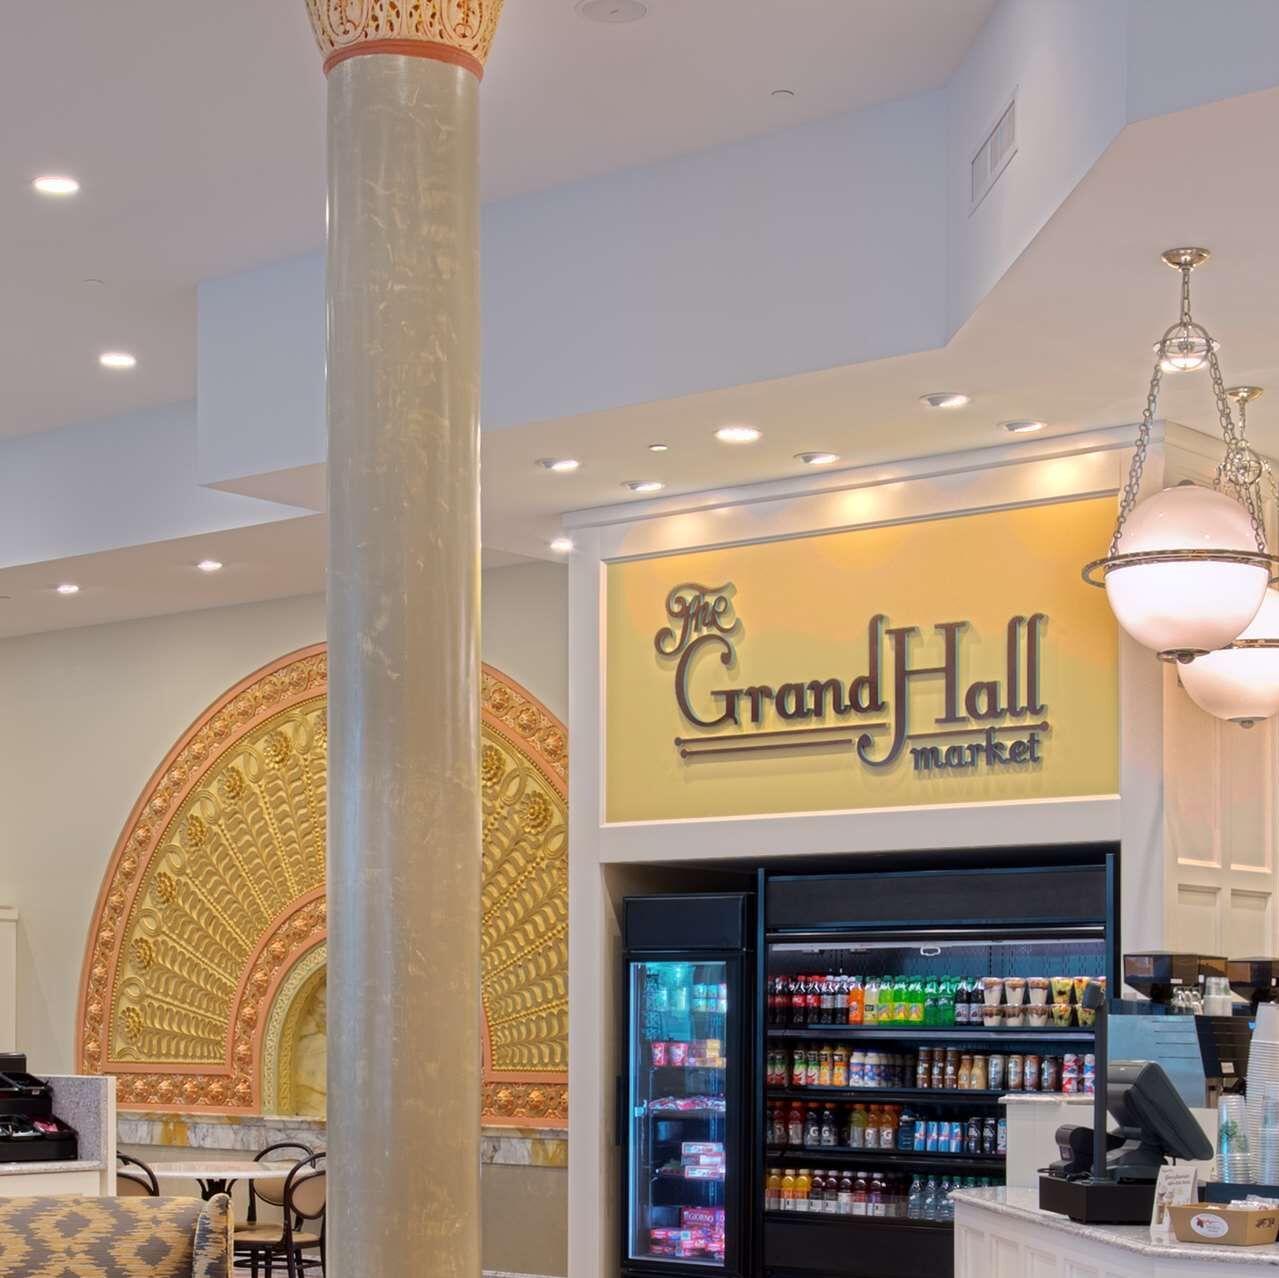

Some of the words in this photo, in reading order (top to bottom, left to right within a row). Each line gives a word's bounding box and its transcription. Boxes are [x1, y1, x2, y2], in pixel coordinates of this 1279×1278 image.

[654, 581, 742, 656] The
[674, 614, 887, 728] Grand
[857, 612, 1048, 767] Hall
[909, 727, 1041, 772] market
